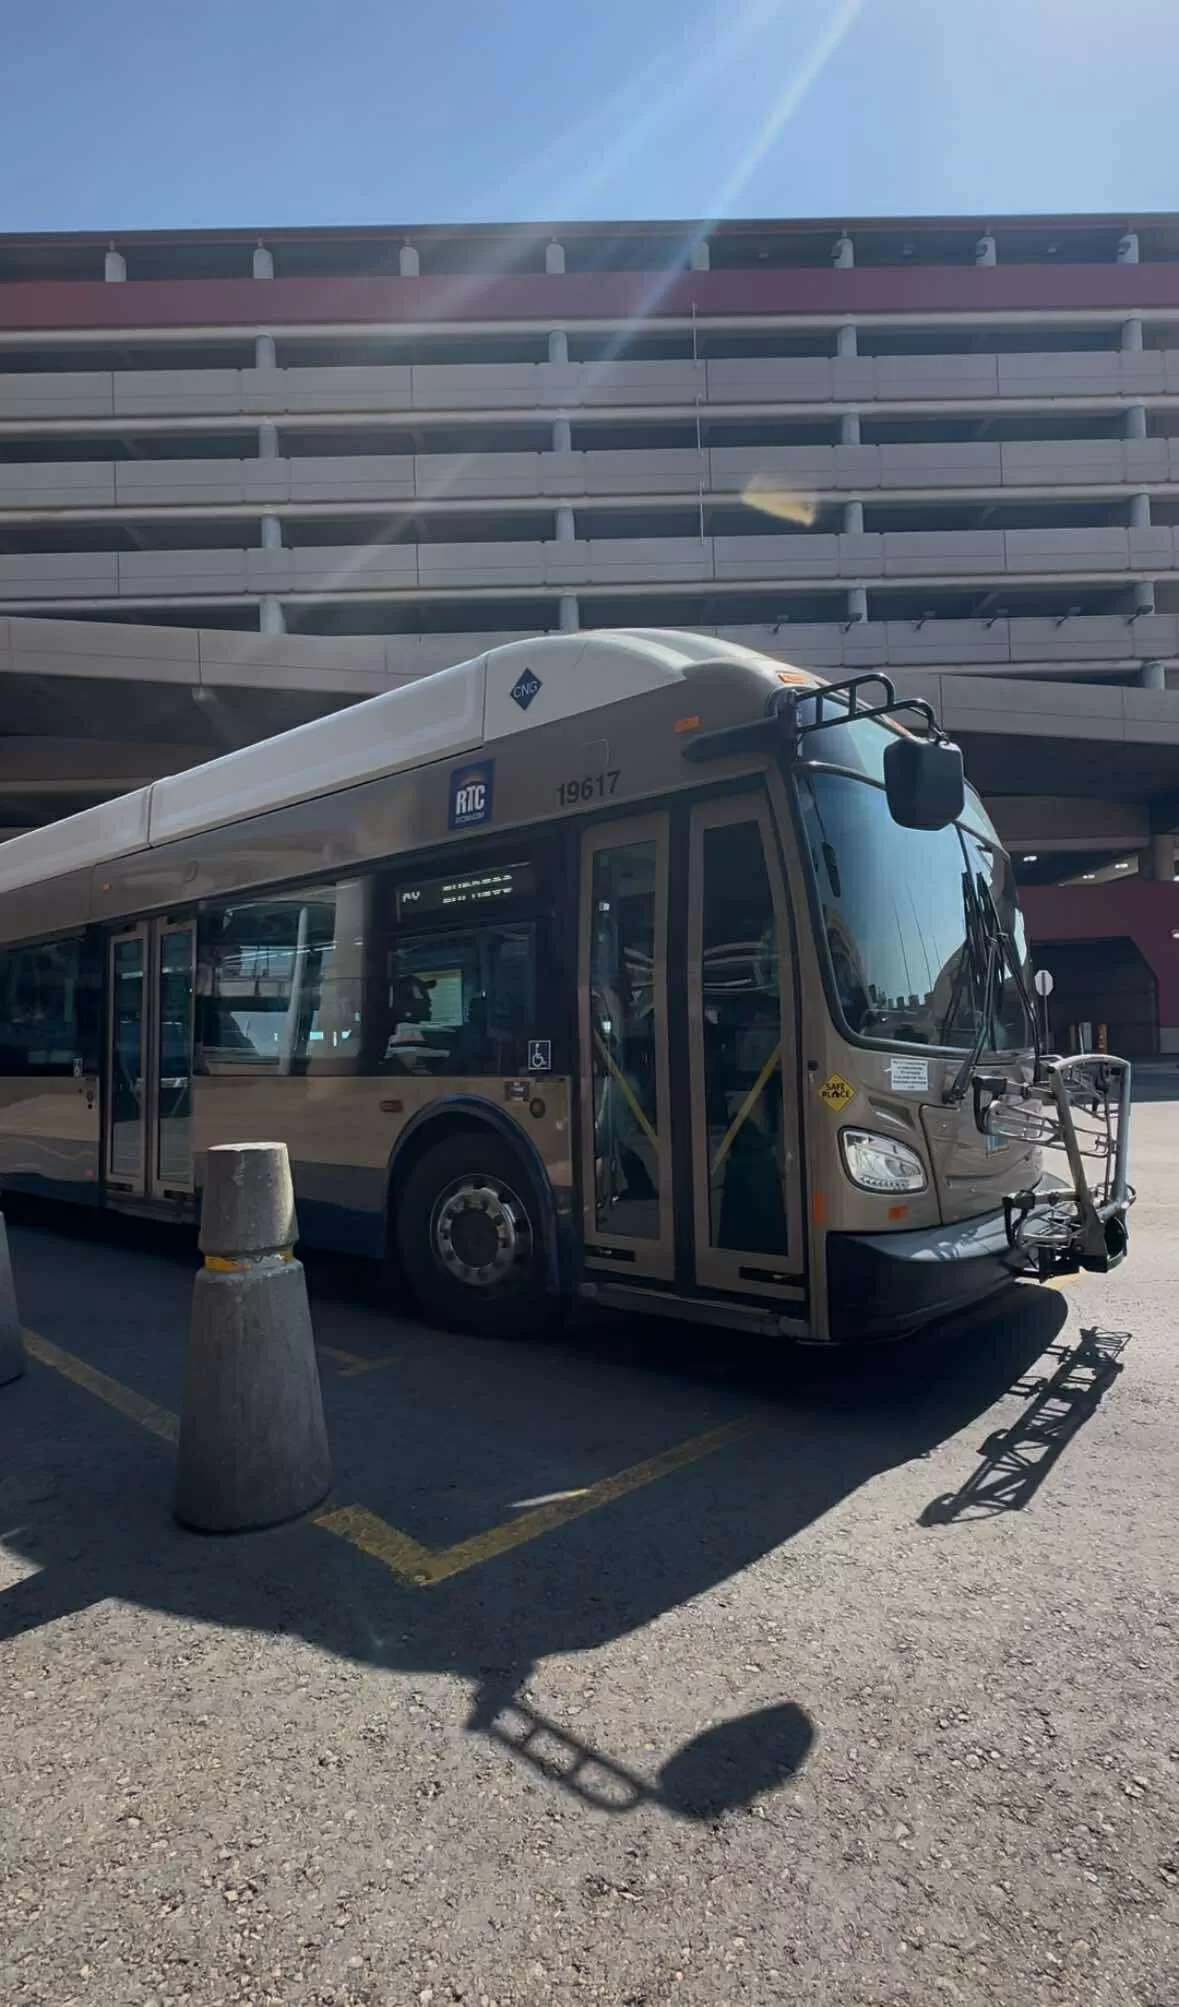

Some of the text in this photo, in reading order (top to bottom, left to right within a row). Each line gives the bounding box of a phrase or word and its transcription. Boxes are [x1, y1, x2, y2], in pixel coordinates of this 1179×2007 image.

[513, 681, 537, 697] CNG
[556, 769, 621, 806] 19617
[456, 785, 485, 815] RTC
[825, 1082, 845, 1091] SAFE
